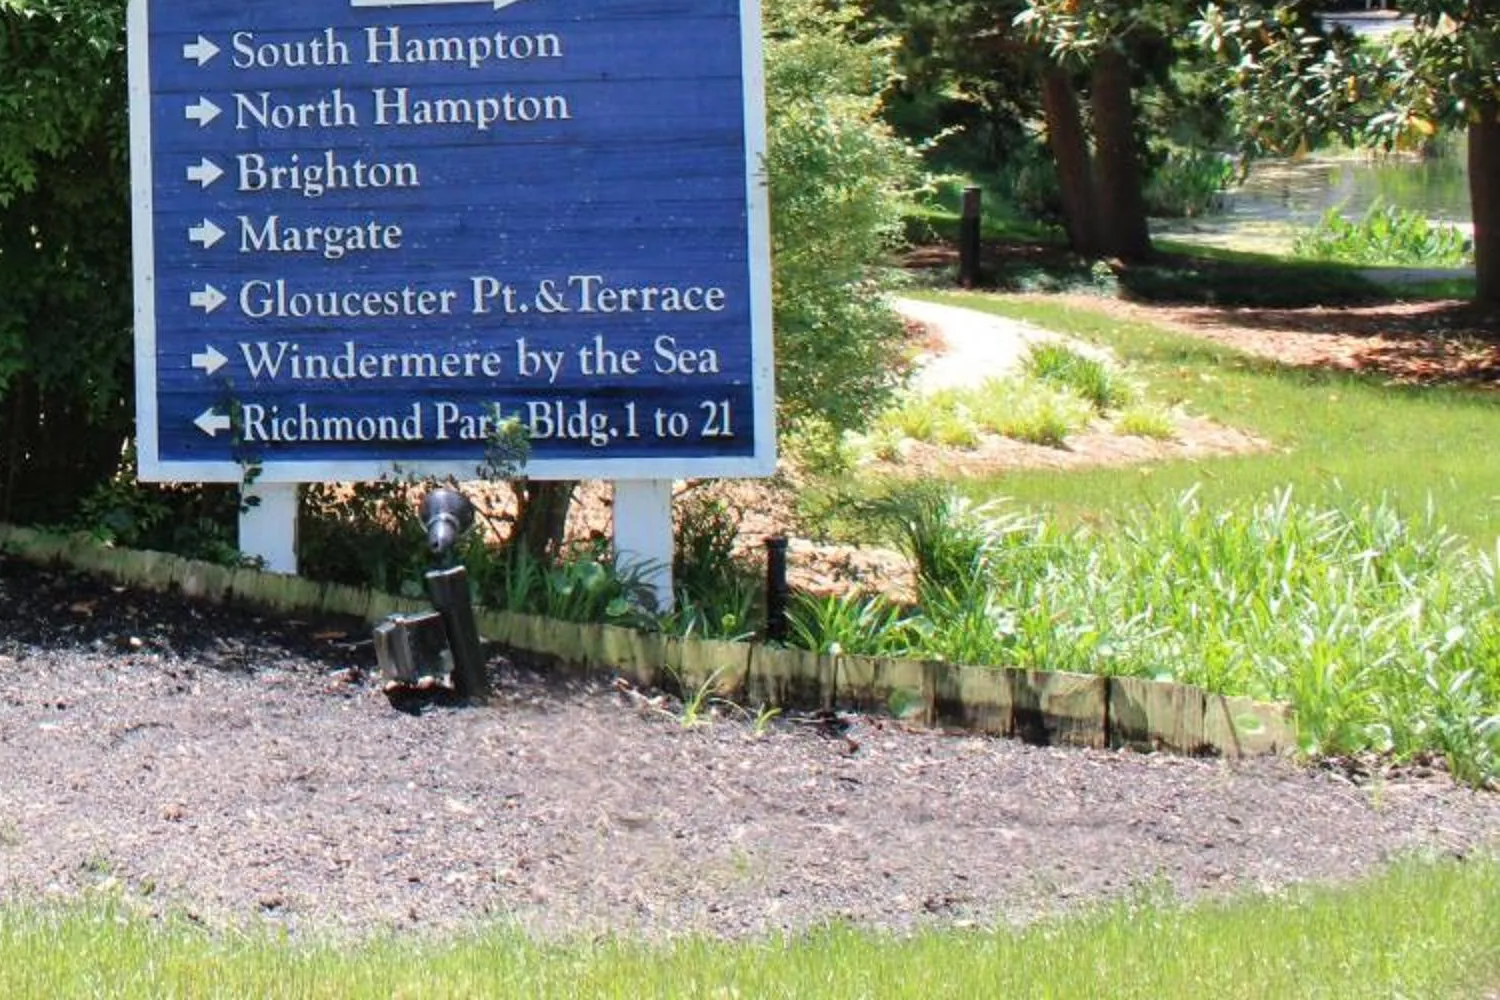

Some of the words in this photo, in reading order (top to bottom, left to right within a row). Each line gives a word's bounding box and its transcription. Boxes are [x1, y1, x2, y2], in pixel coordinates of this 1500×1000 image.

[231, 27, 350, 68] South
[365, 26, 563, 70] Hampton
[234, 88, 357, 130] North
[372, 87, 571, 130] Hampton
[236, 149, 420, 197] Brighton
[238, 215, 403, 258] Margate
[239, 278, 456, 317] Gloucester
[238, 339, 501, 380] Windermere
[516, 336, 564, 384] by
[579, 332, 642, 374] the
[653, 334, 719, 374] Sea
[243, 402, 422, 441] Richmond
[654, 404, 690, 438] to
[700, 399, 735, 438] 21
